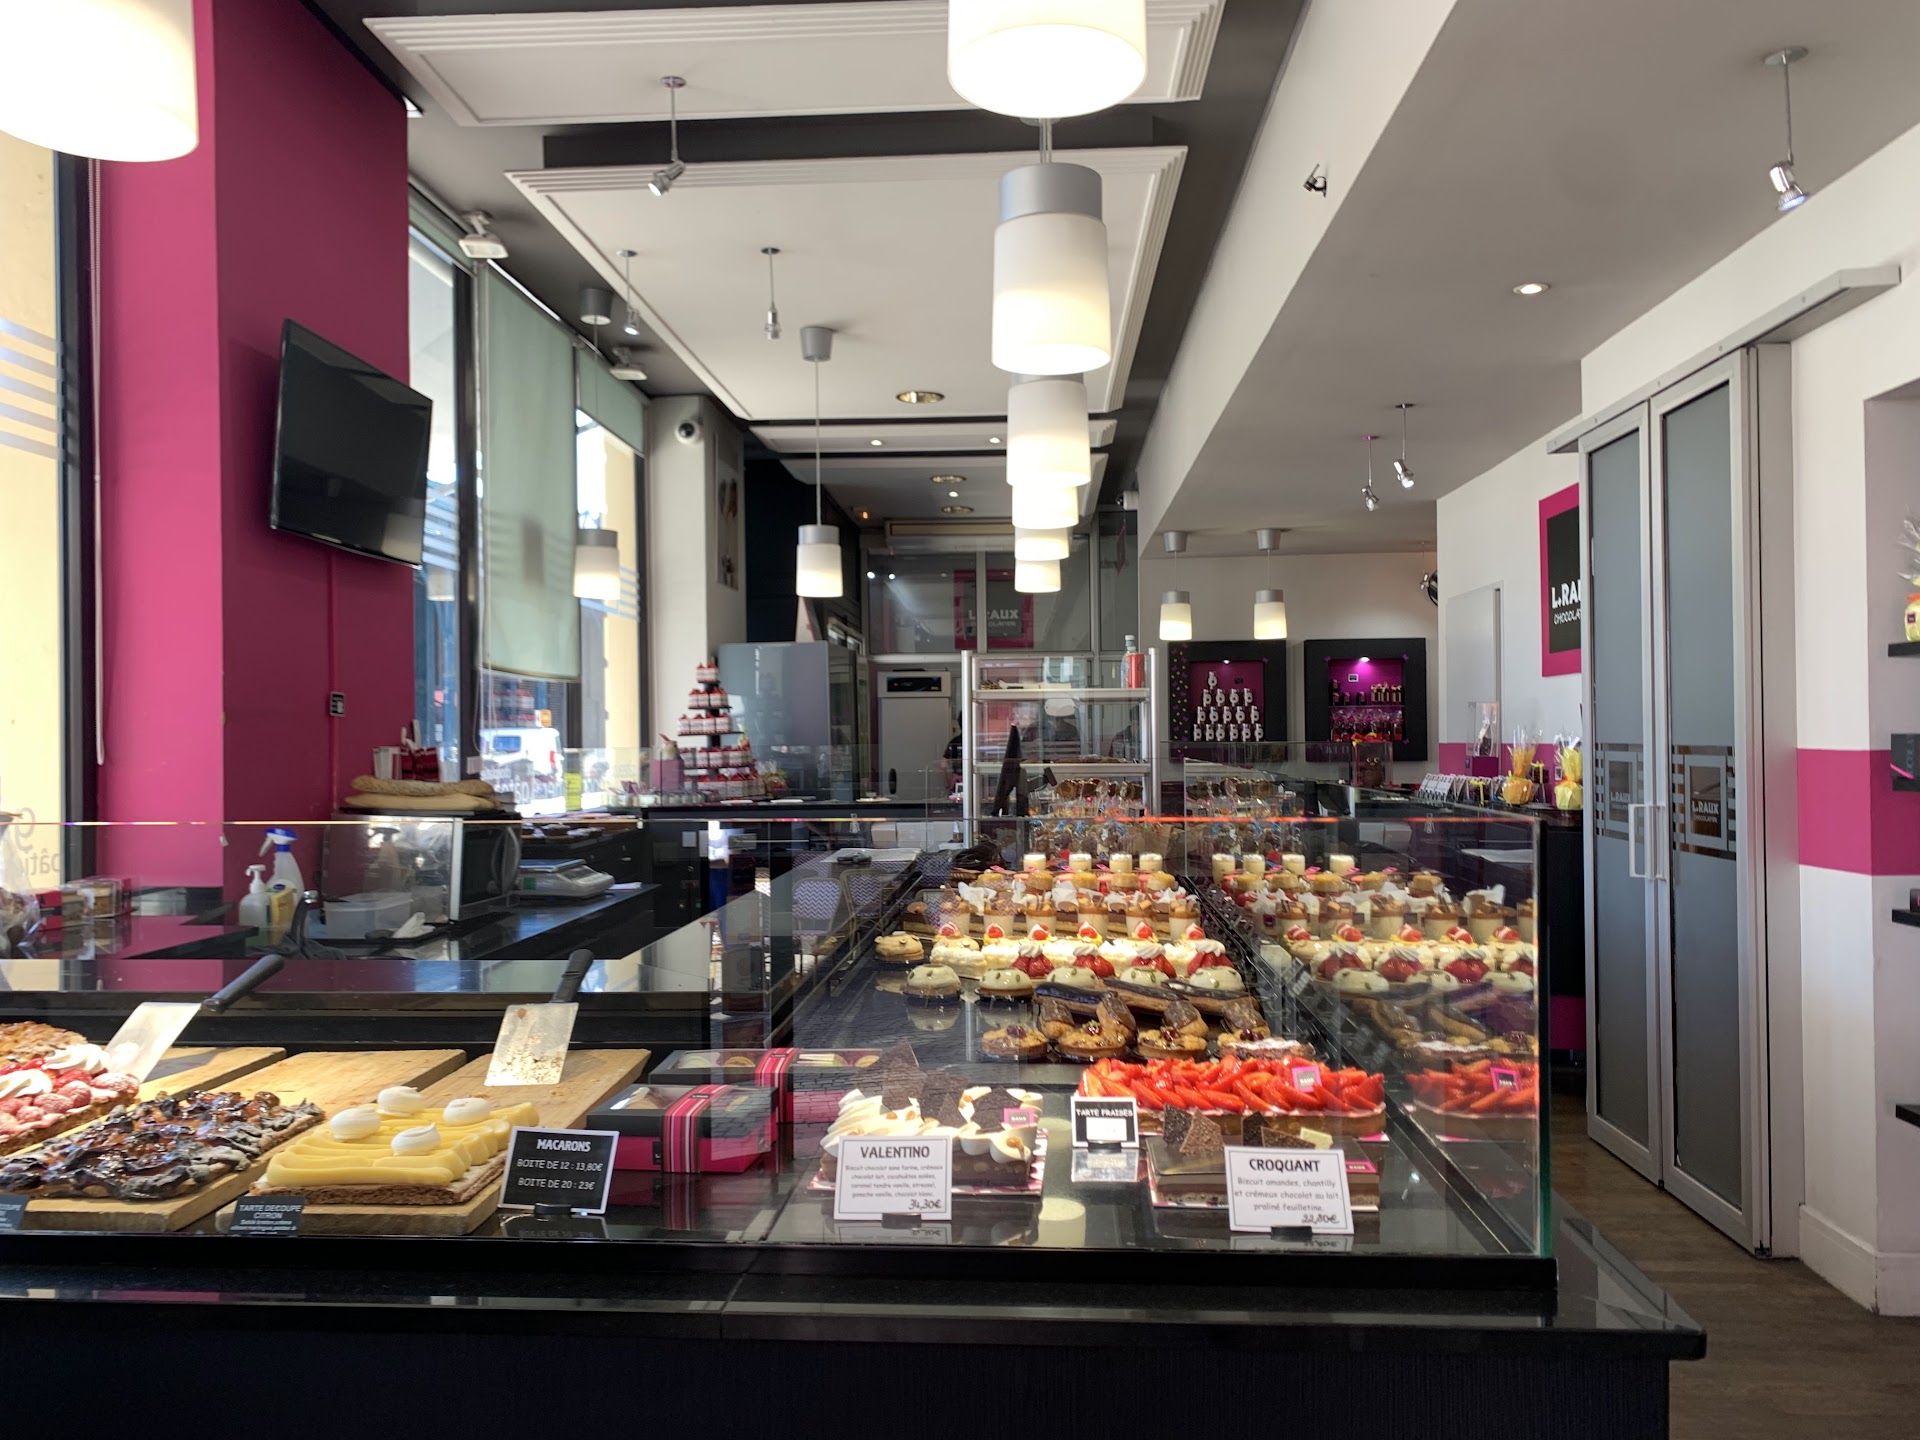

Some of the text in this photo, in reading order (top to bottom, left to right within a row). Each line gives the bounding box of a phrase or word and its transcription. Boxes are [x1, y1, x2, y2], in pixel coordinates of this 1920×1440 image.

[1076, 1108, 1134, 1117] TARTE FRAISES
[537, 1139, 591, 1152] MACARONS
[860, 1146, 931, 1158] VALENTINO
[517, 1159, 545, 1169] BOITE
[546, 1161, 559, 1170] DE
[560, 1162, 570, 1170] 12
[576, 1162, 604, 1172] 13,80€
[1249, 1158, 1321, 1173] CROQUANT
[518, 1178, 547, 1188] BOITE
[547, 1180, 560, 1188] DE
[561, 1180, 573, 1189] 20
[578, 1181, 596, 1190] 23€
[1237, 1177, 1337, 1189] Biscuit amandes, chantilly
[1245, 1191, 1278, 1199] crémeux
[1280, 1191, 1313, 1200] chocolat
[239, 1204, 264, 1212] TARTE
[1253, 1203, 1280, 1212] praliné
